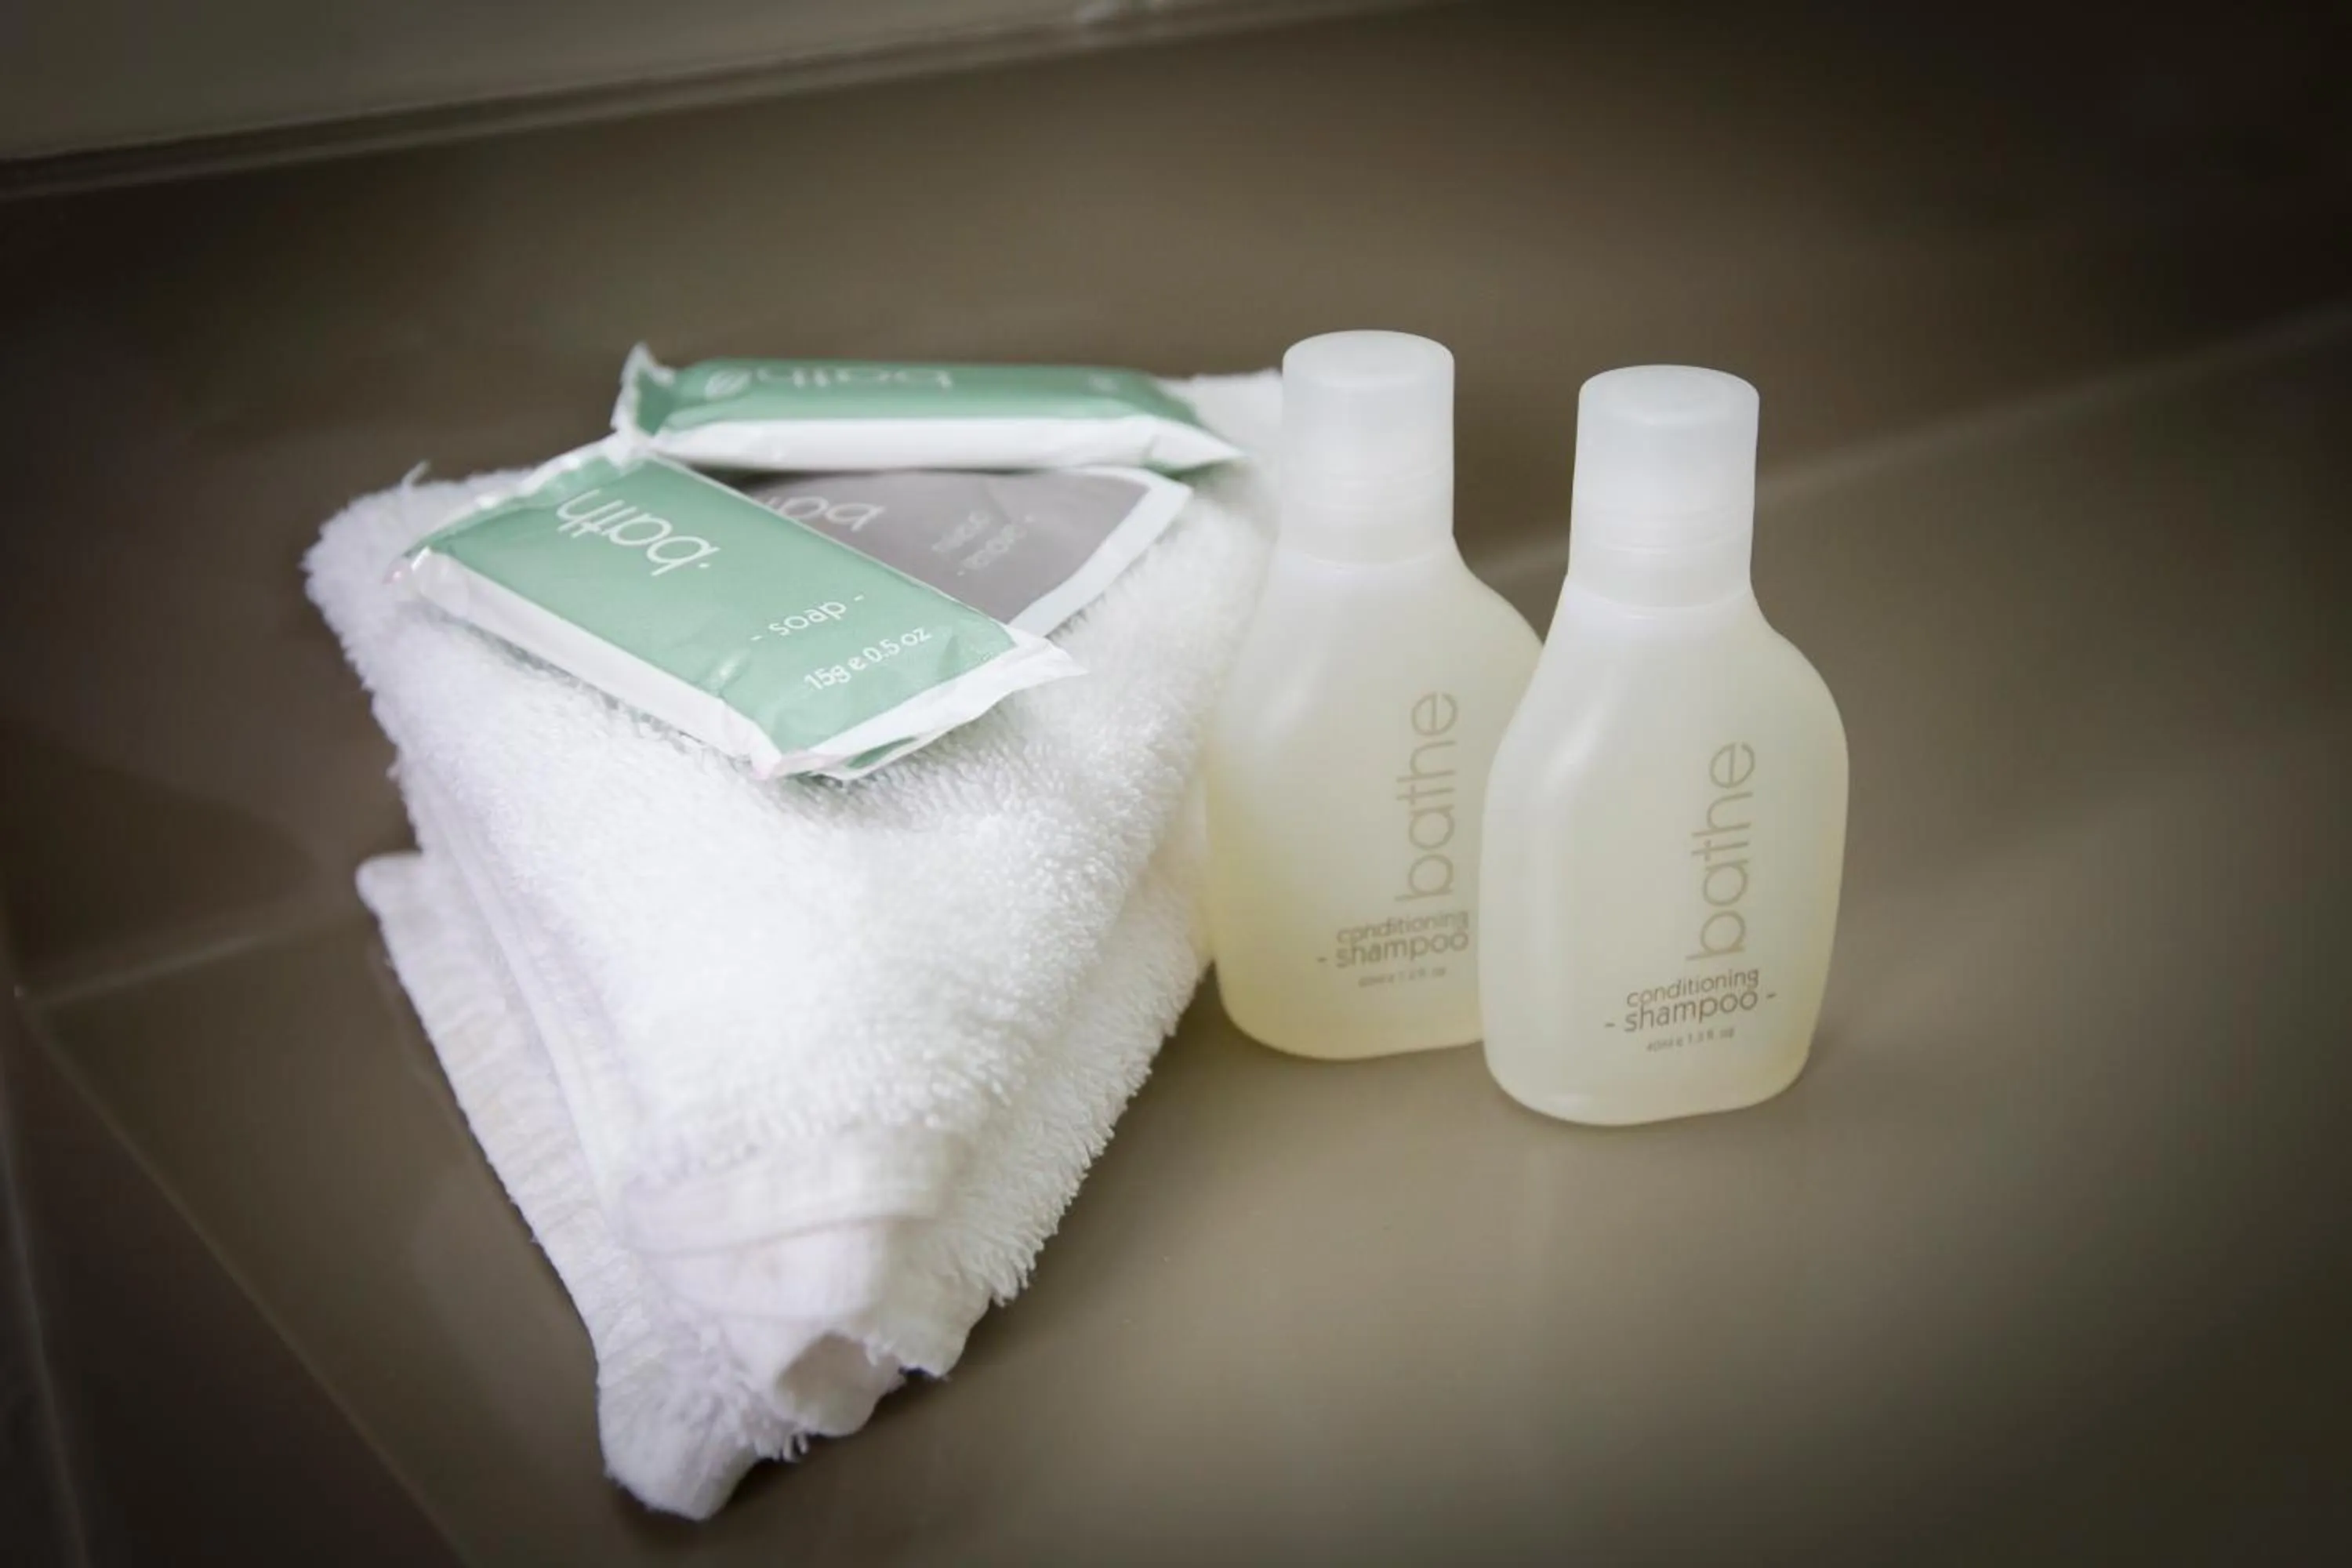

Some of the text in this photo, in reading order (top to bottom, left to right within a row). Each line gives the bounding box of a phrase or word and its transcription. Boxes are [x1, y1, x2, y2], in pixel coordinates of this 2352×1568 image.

[768, 601, 847, 636] soap
[804, 665, 851, 690] 15g
[862, 638, 900, 663] 0.5
[901, 627, 933, 646] oz
[1394, 691, 1458, 902] bathe
[1685, 741, 1756, 963] bathe
[1336, 910, 1469, 943] conditioning
[1335, 931, 1470, 969] shampoo
[1626, 968, 1759, 1007] conditioning
[1624, 990, 1759, 1033] shampoo
